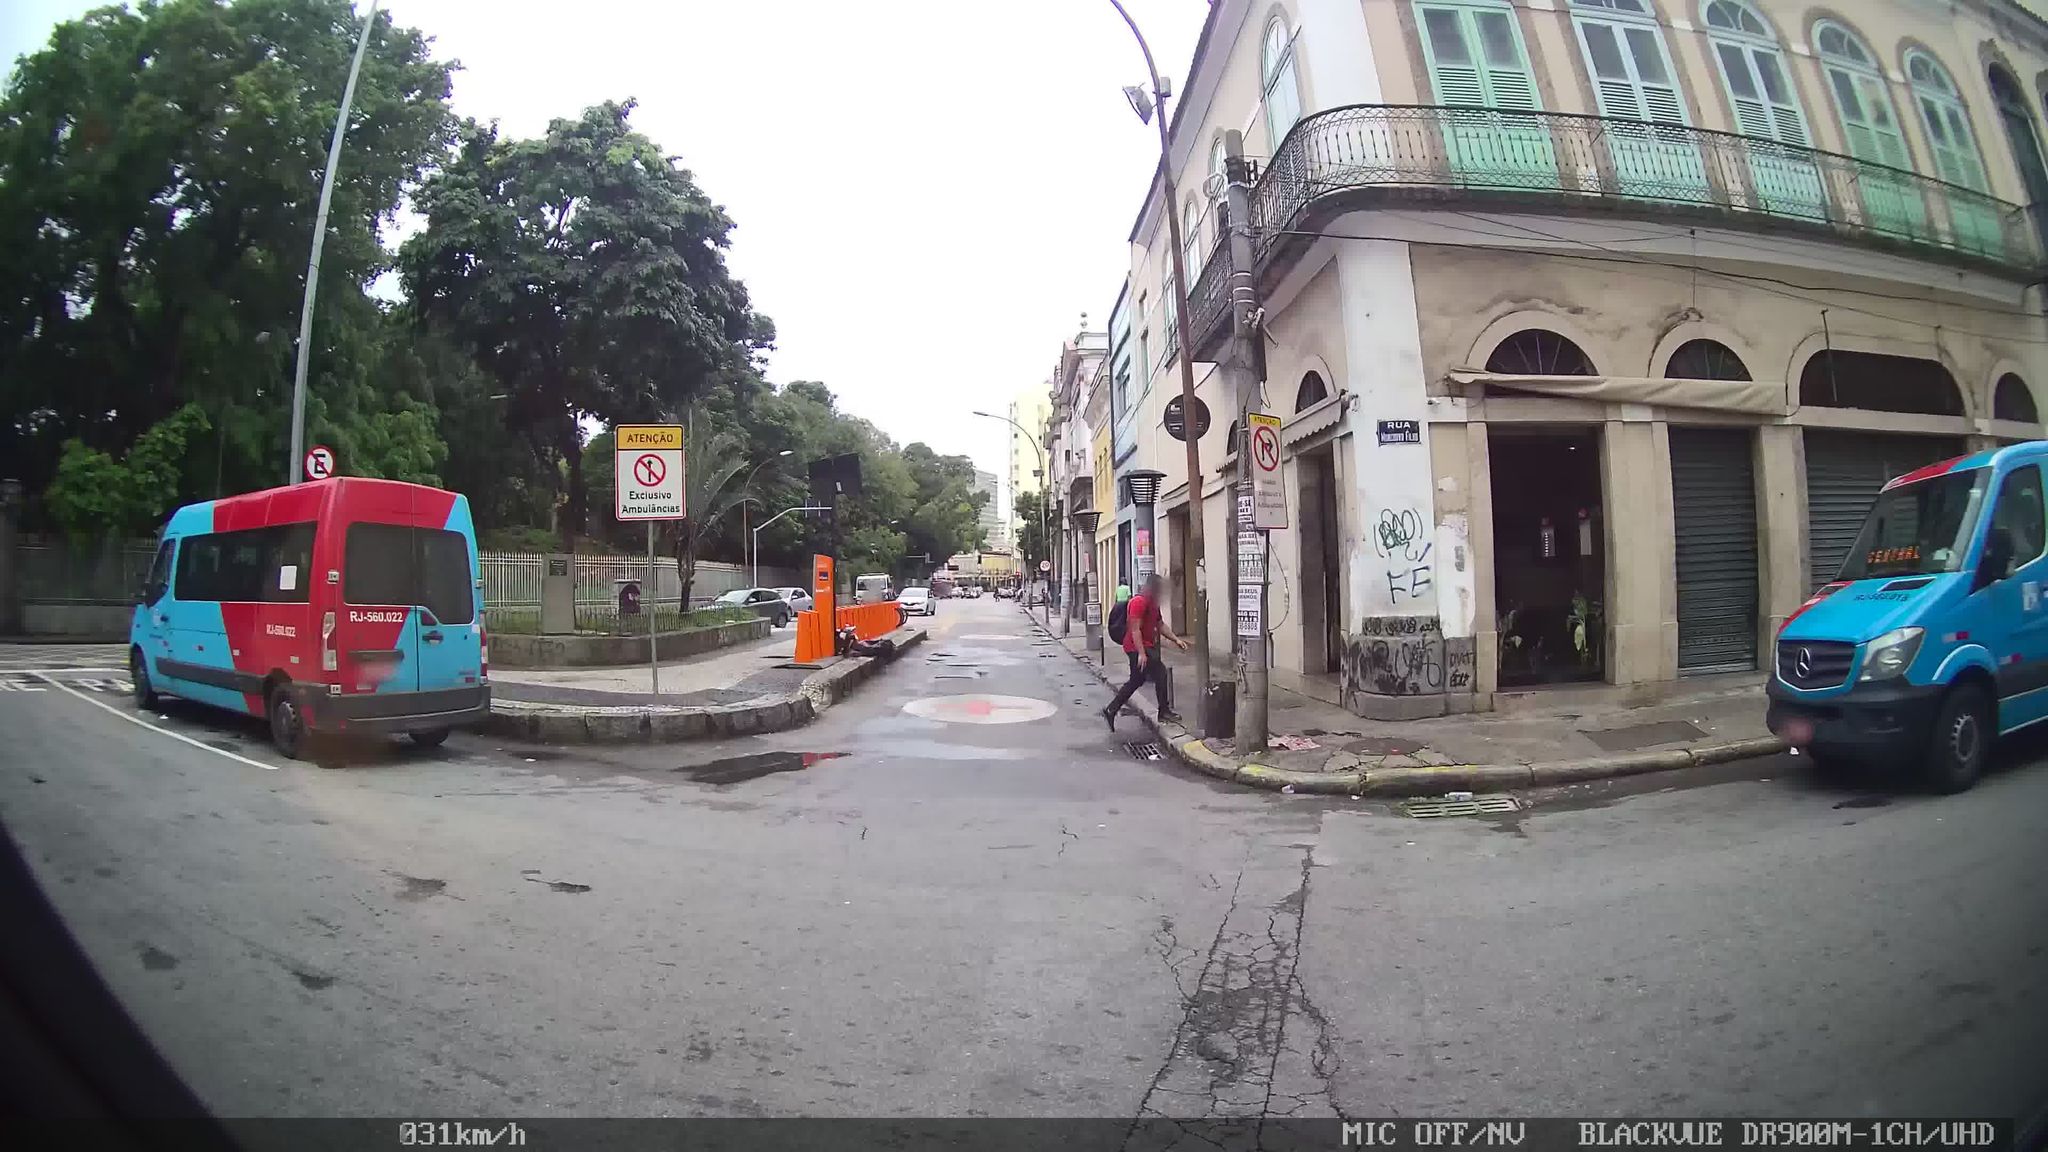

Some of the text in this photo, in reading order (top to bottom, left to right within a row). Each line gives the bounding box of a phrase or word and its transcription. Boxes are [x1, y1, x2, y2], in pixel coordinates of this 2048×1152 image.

[1387, 421, 1411, 430] RUA
[626, 432, 674, 444] ATENÇÃO
[629, 490, 672, 500] Exclusivo
[621, 503, 681, 514] Ambulâncias
[349, 610, 404, 623] RJ-560.022
